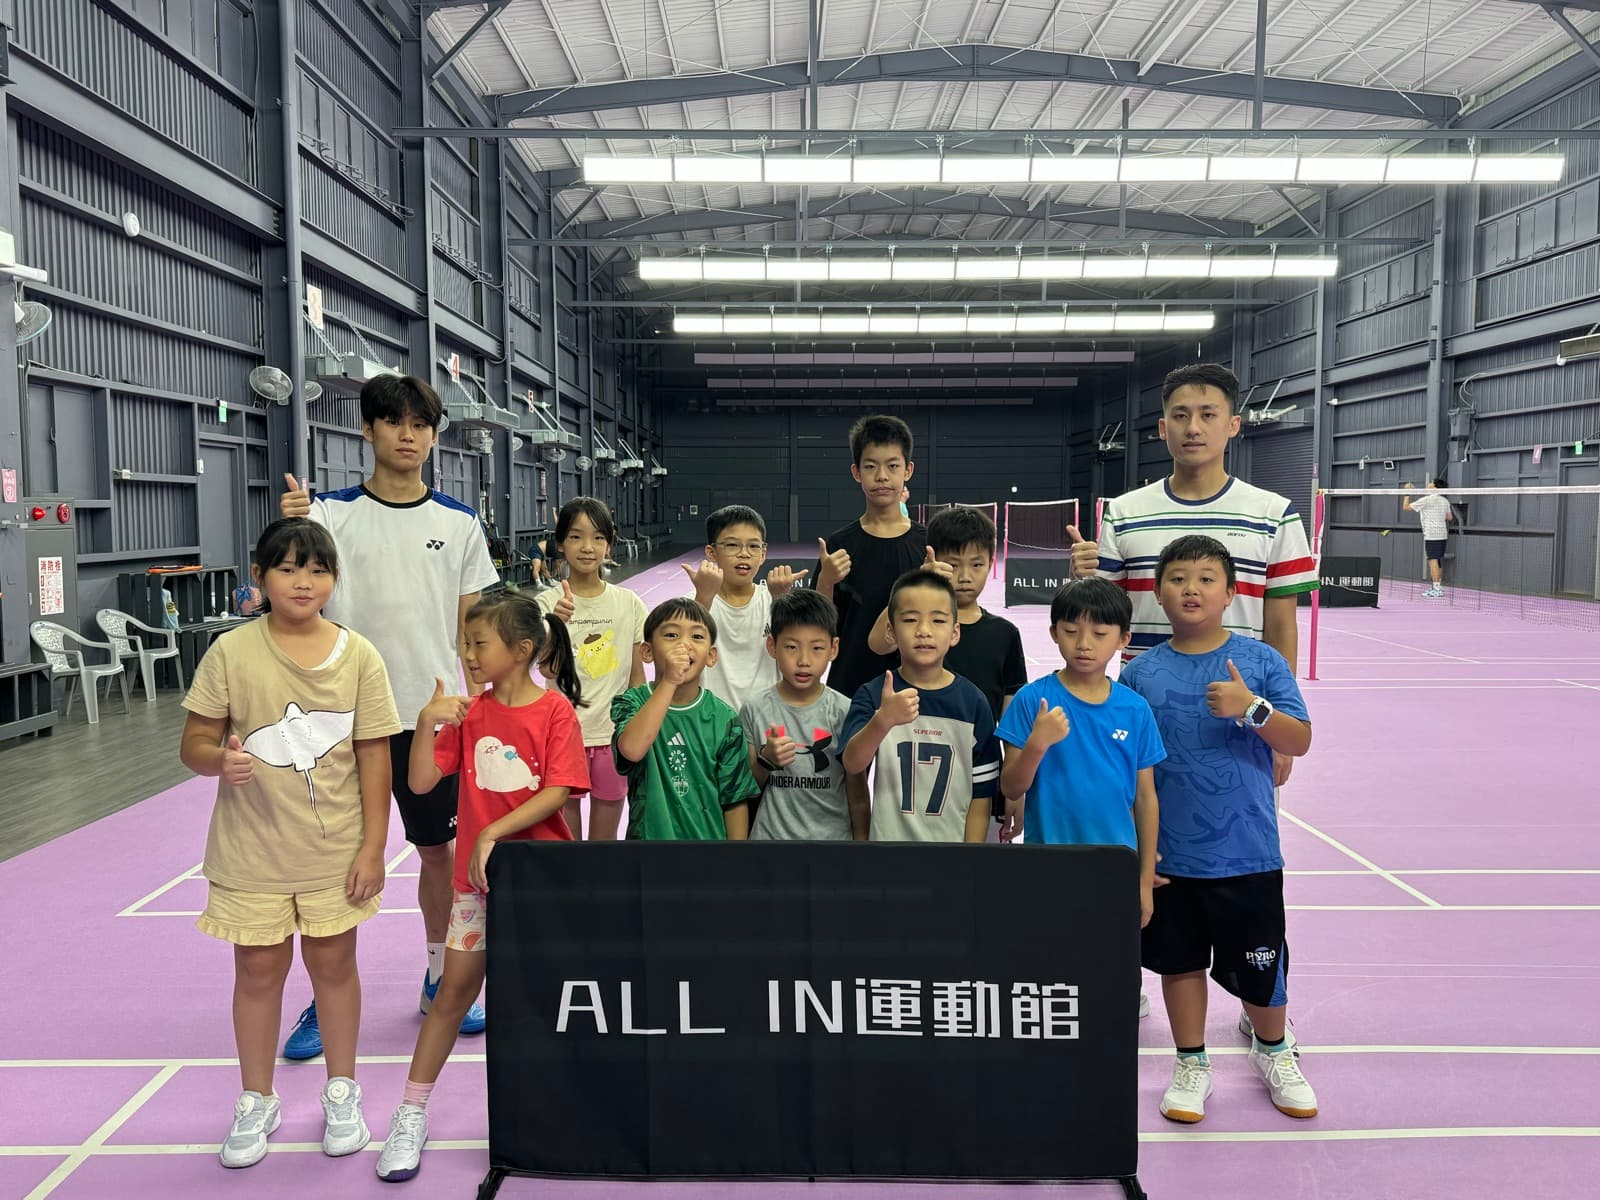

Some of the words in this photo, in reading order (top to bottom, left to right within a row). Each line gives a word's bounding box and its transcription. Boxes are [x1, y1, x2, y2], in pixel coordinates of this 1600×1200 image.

[1013, 577, 1040, 588] ALL
[1044, 578, 1058, 588] IN
[1320, 576, 1334, 586] IN
[896, 741, 956, 817] 17
[1245, 950, 1276, 961] PYRO
[556, 980, 726, 1034] ALL
